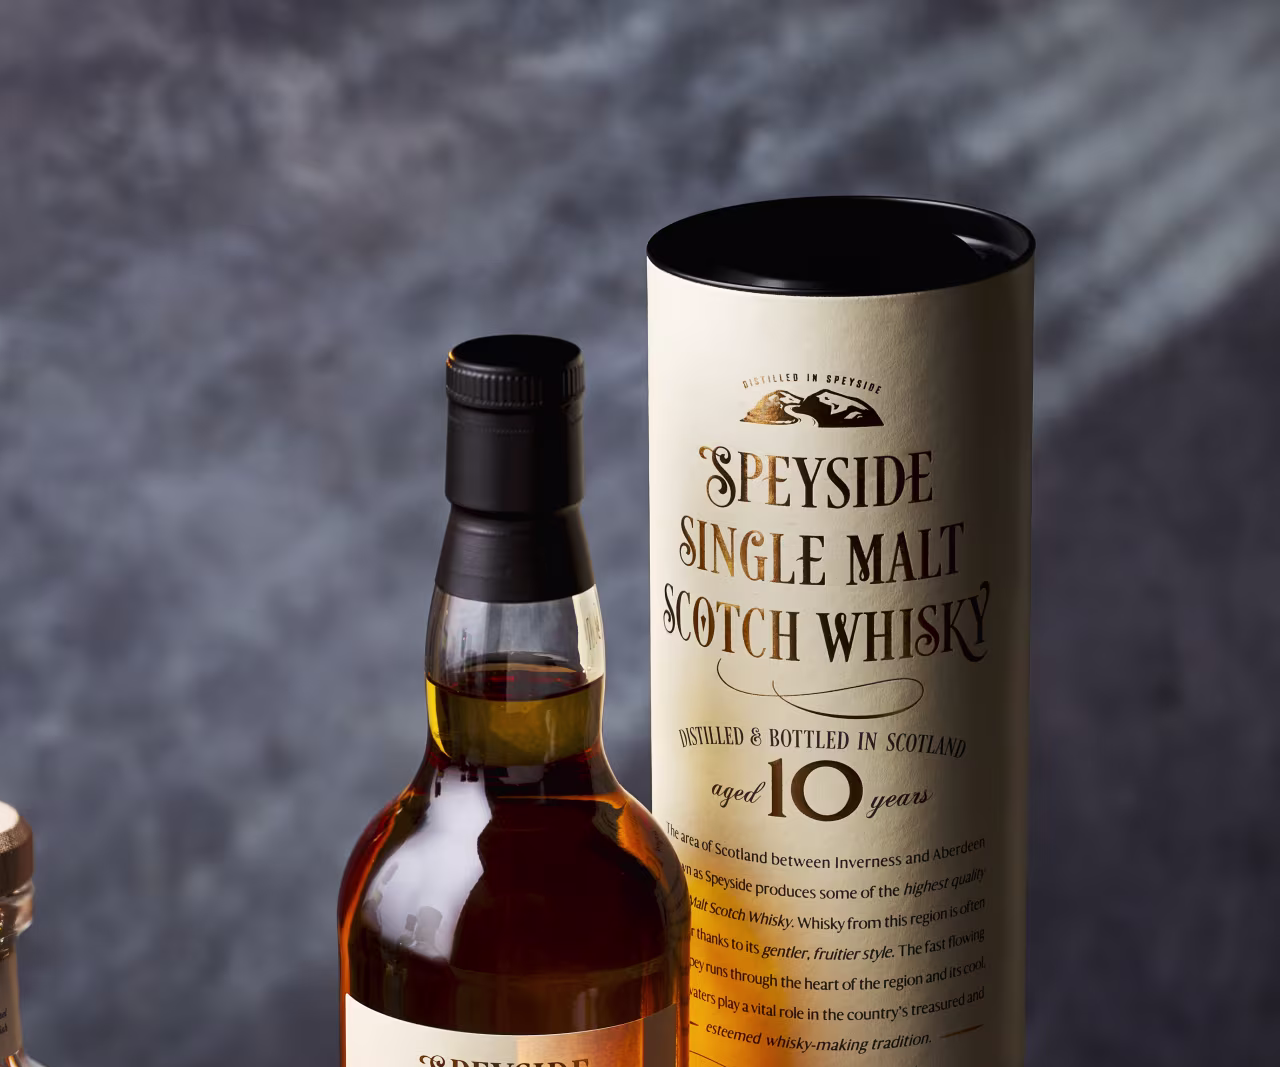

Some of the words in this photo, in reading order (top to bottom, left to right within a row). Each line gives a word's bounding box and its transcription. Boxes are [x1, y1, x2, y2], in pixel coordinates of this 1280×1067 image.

[742, 373, 798, 389] DISTILLED
[807, 374, 818, 382] IN
[826, 375, 883, 395] SPEYSIDE
[698, 446, 933, 508] SPEYSIDE
[679, 515, 826, 585] SINGLE
[846, 522, 964, 585] MALT
[663, 583, 800, 662] SCOTCH
[816, 581, 990, 663] WHISKY
[679, 726, 744, 748] DISTILLED
[750, 727, 762, 746] &
[770, 728, 849, 750] BOTTLED
[858, 732, 876, 751] IN
[886, 732, 967, 758] SCOTLAND
[712, 781, 766, 808] aged
[767, 758, 863, 821] 10
[866, 787, 933, 819] years
[666, 821, 680, 841] The
[681, 832, 700, 849] area
[702, 840, 713, 853] of
[715, 843, 768, 865] Scotland
[771, 853, 831, 869] between
[834, 853, 902, 869] Inverness
[905, 850, 930, 865] and
[932, 837, 985, 861] Aberdeen
[706, 1021, 762, 1044] esteemed
[766, 1036, 868, 1054] whisky-making
[872, 1032, 932, 1050] tradition.
